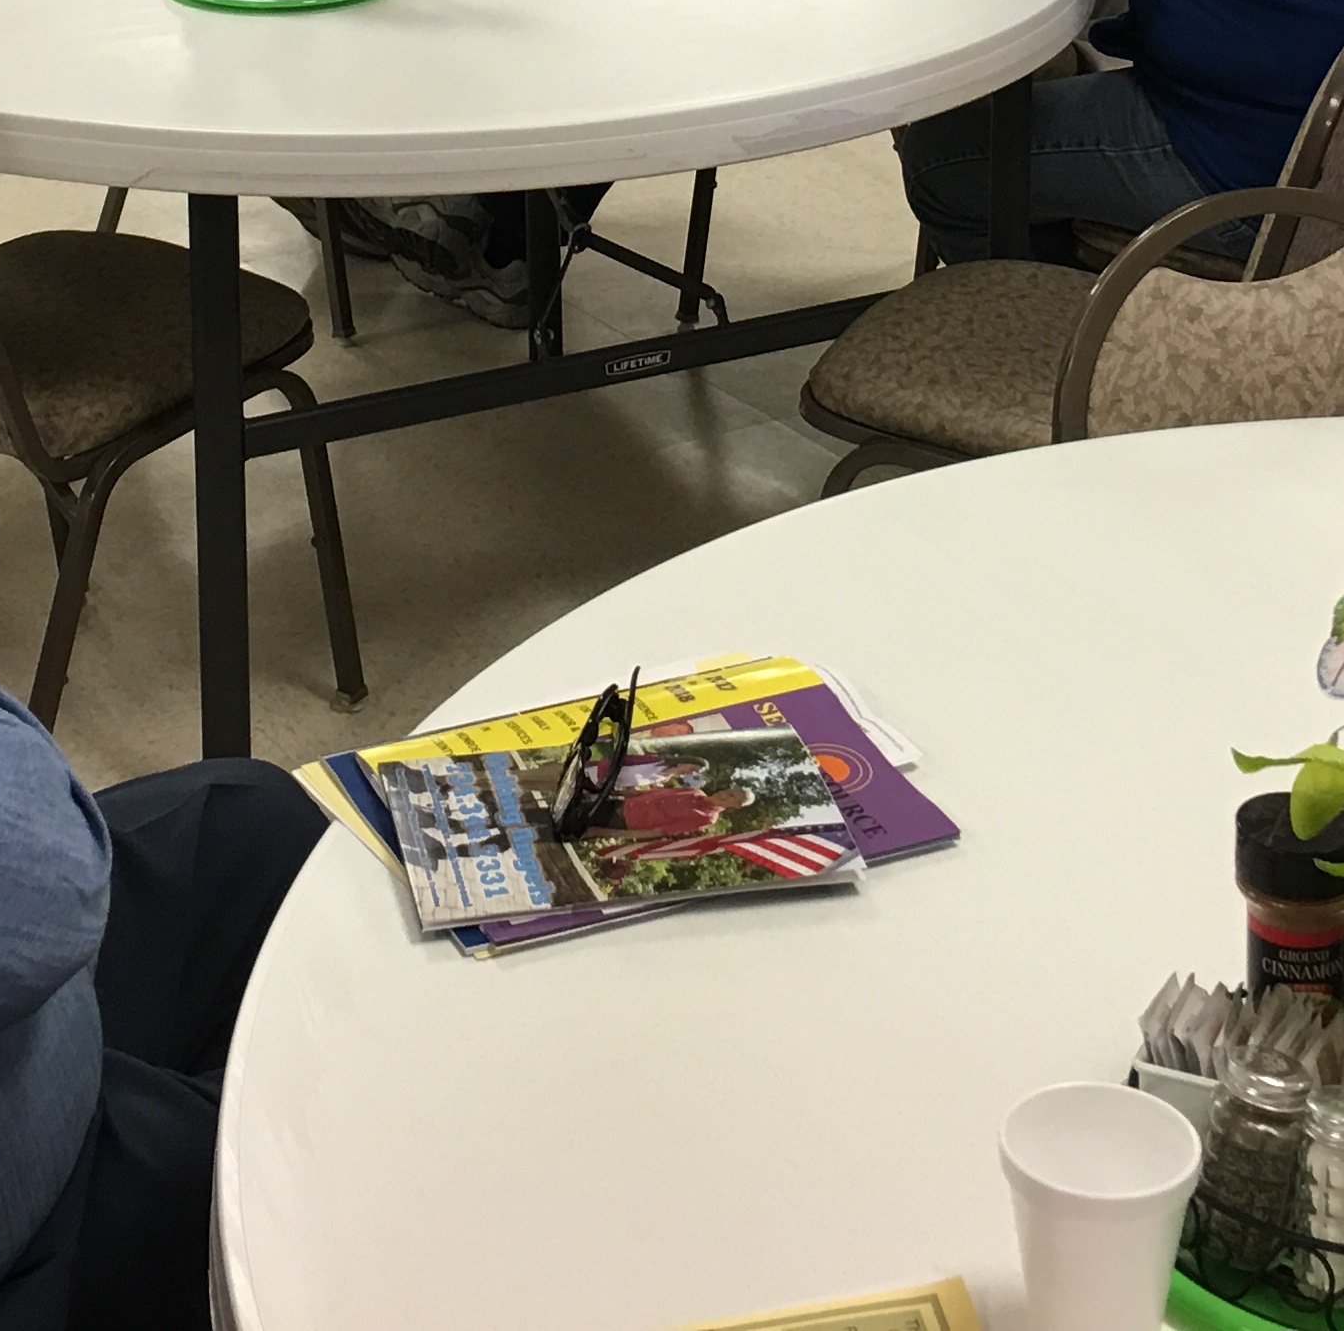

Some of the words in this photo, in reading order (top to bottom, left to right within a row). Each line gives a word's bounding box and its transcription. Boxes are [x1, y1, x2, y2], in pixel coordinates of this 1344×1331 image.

[613, 354, 663, 372] LIFETIME
[505, 720, 533, 745] SERVICES
[508, 826, 554, 907] Angels
[1262, 956, 1344, 980] CINNAMON
[1279, 949, 1330, 963] GROUND
